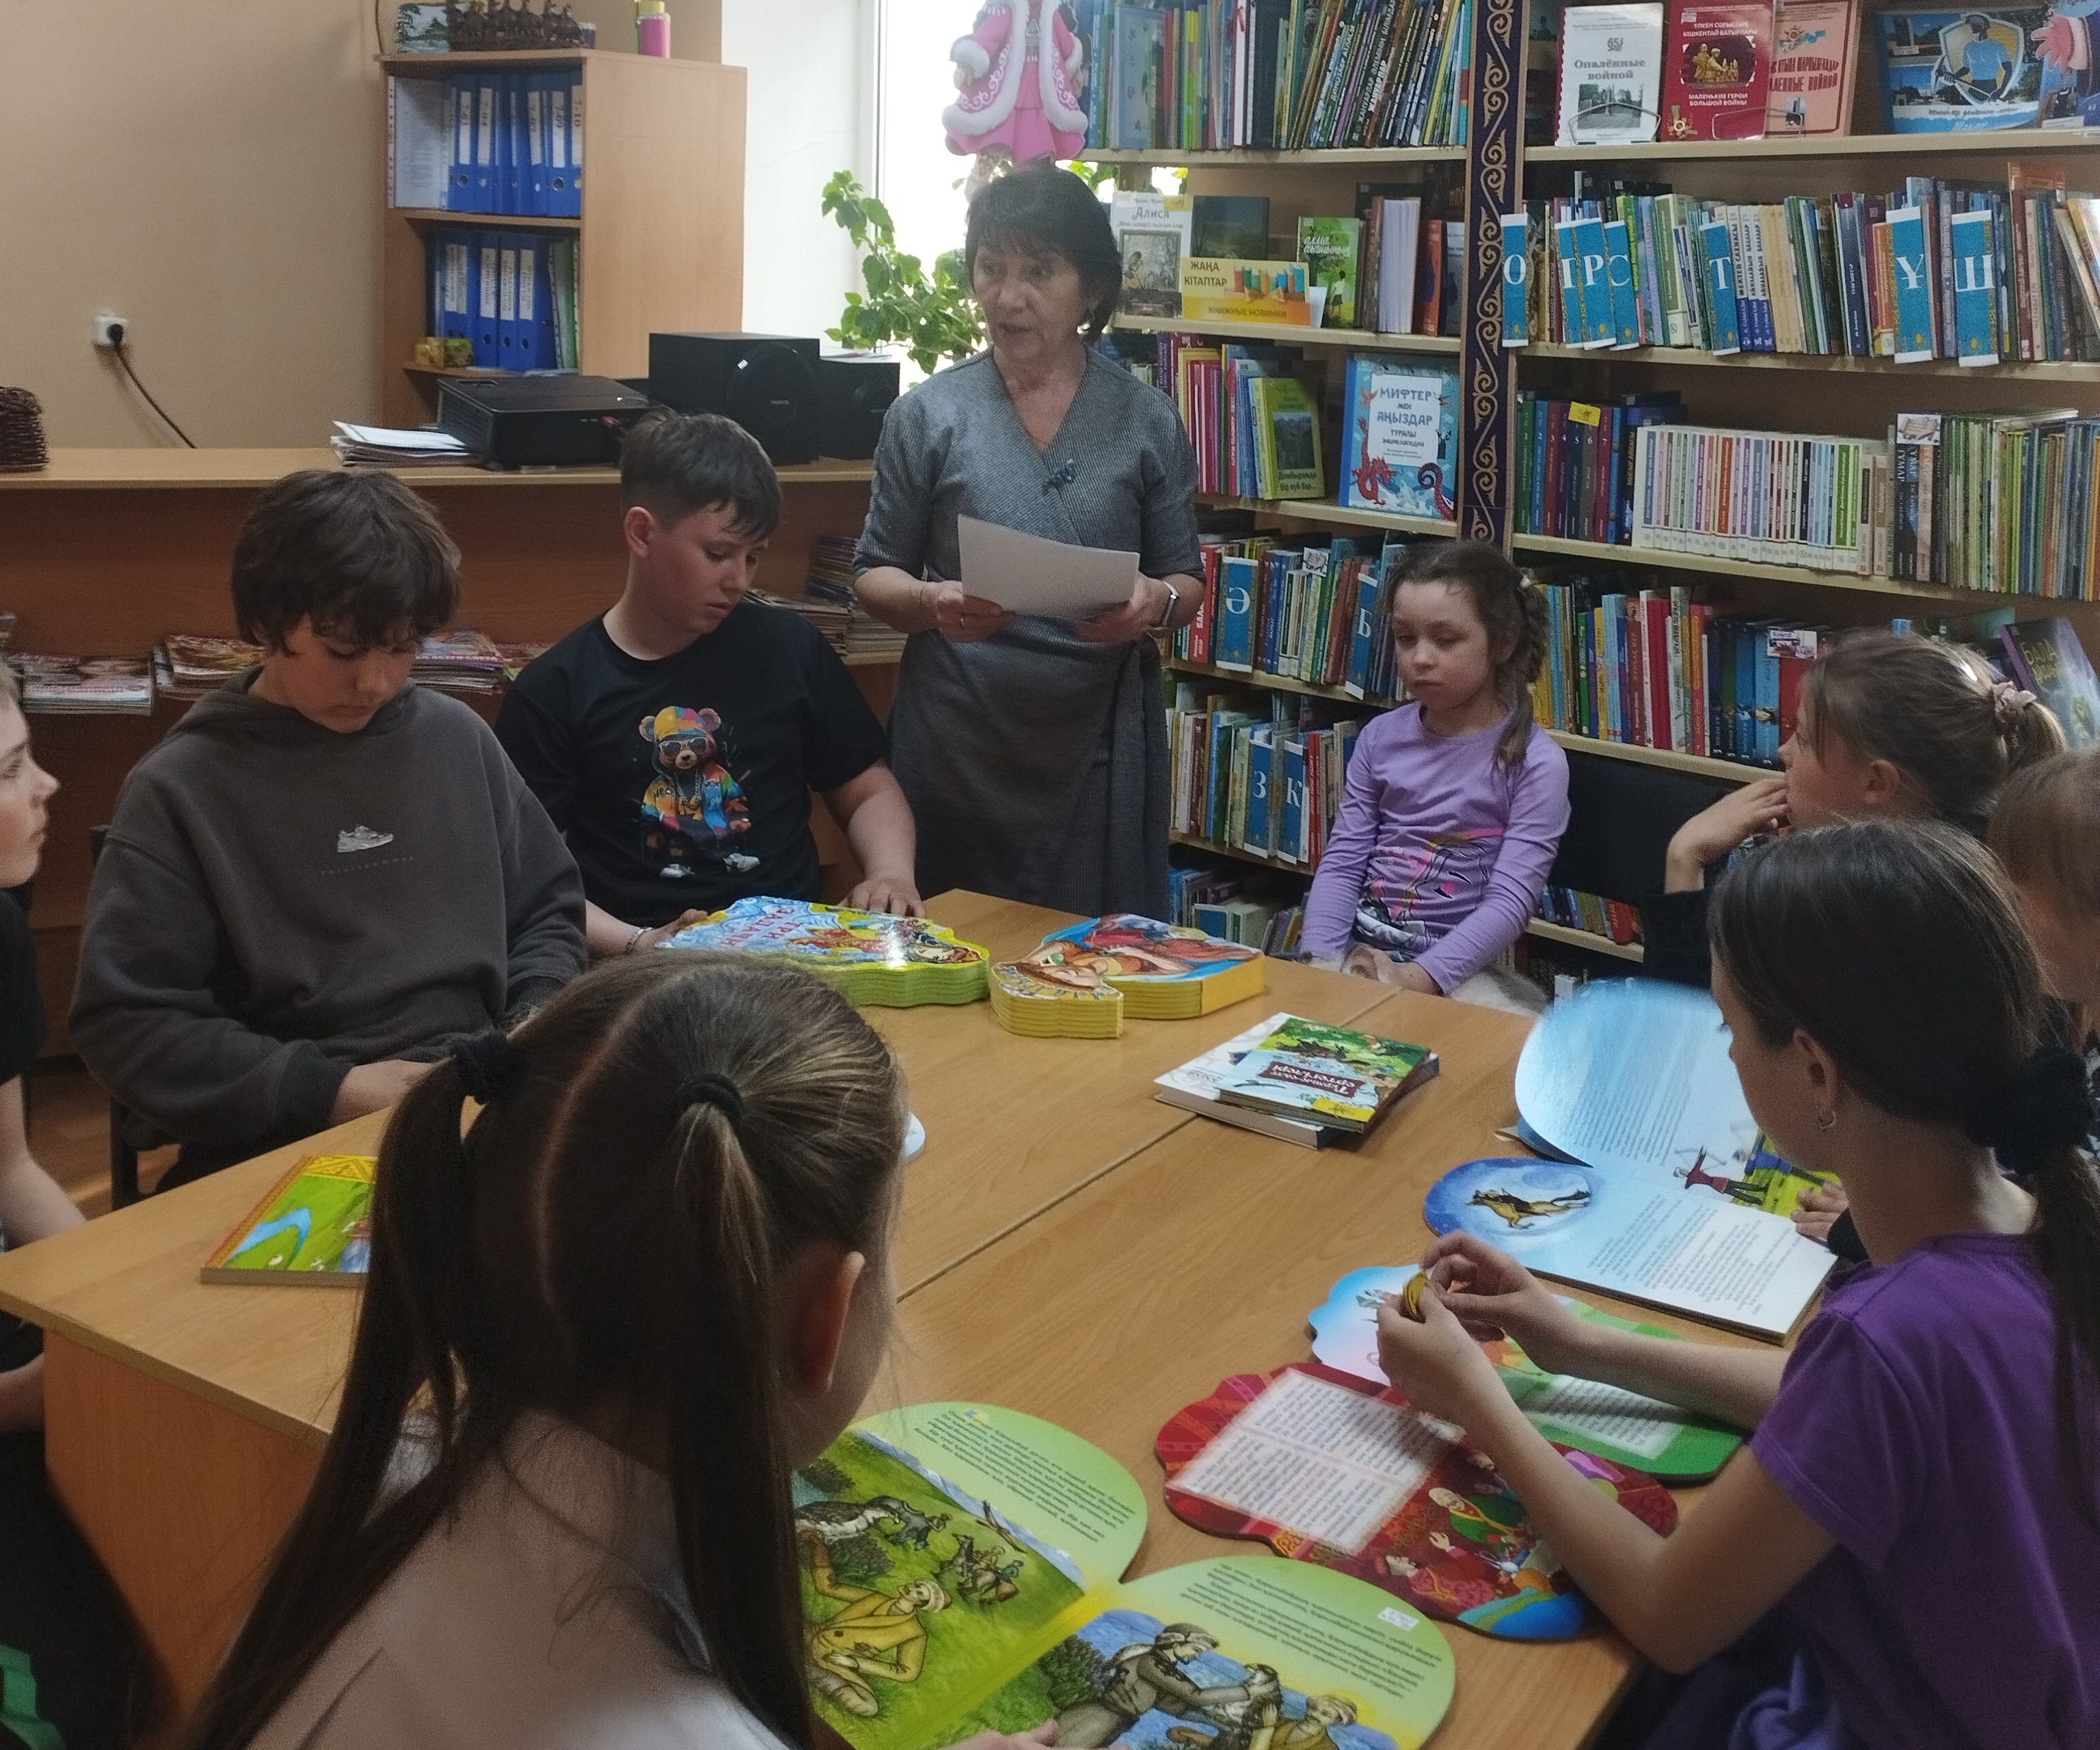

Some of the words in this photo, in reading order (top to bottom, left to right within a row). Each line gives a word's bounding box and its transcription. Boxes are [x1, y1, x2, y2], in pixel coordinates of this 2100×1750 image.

[1574, 59, 1646, 68] Опалённые
[1588, 70, 1633, 80] войной
[1190, 261, 1220, 273] ЖАҢА
[1583, 254, 1604, 286] Р
[1609, 254, 1630, 286] С
[1710, 257, 1731, 290] Т
[1185, 275, 1228, 288] КІТАПТАР
[1208, 306, 1247, 317] КНИЖНЫЕ
[1248, 309, 1287, 319] НОВИНКИ
[1380, 387, 1431, 401] МИФТЕР
[1377, 411, 1432, 427] АҢЫЗДАР
[1226, 587, 1250, 614] Ә
[1252, 770, 1267, 798] З
[1287, 777, 1302, 807] К
